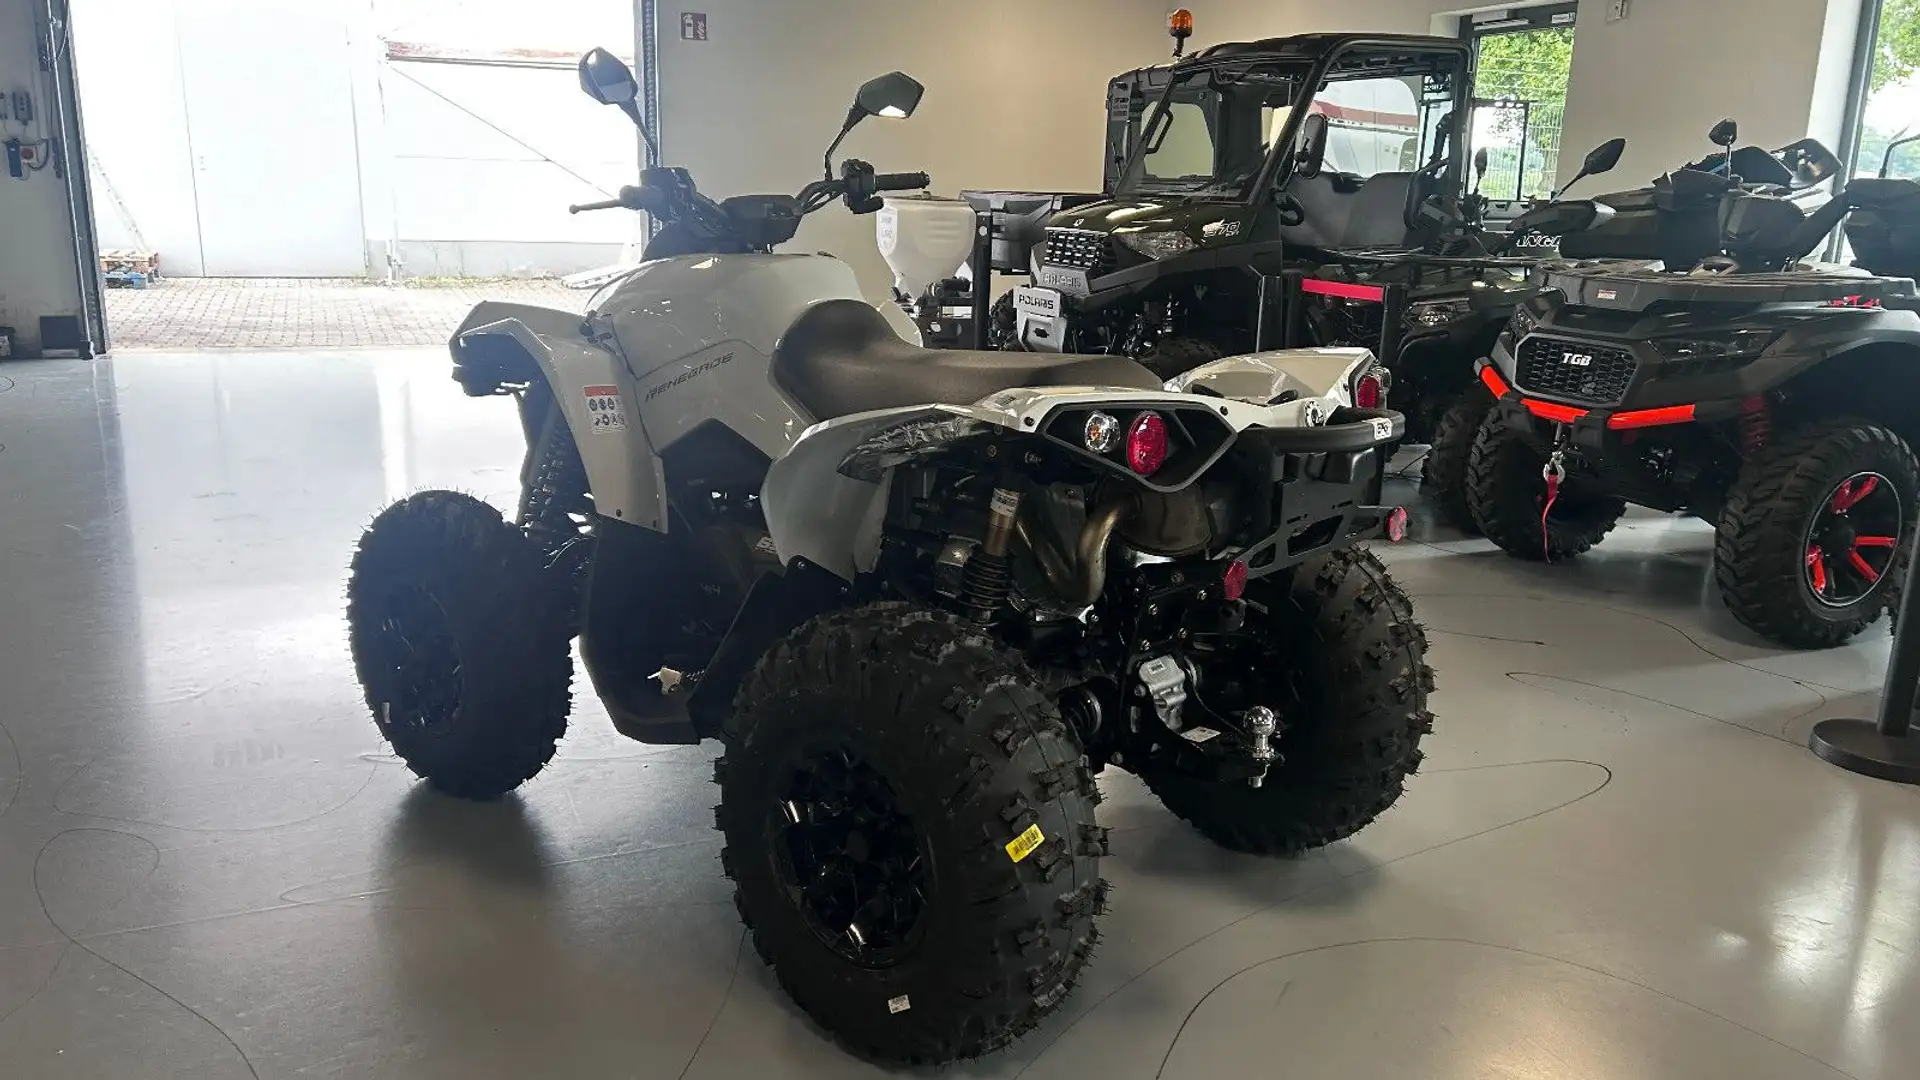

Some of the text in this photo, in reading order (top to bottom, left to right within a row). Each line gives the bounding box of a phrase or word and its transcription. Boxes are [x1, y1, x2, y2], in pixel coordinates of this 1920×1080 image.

[1018, 293, 1054, 310] POLARIS
[1562, 352, 1592, 366] TGB
[644, 351, 735, 404] RENEGADE
